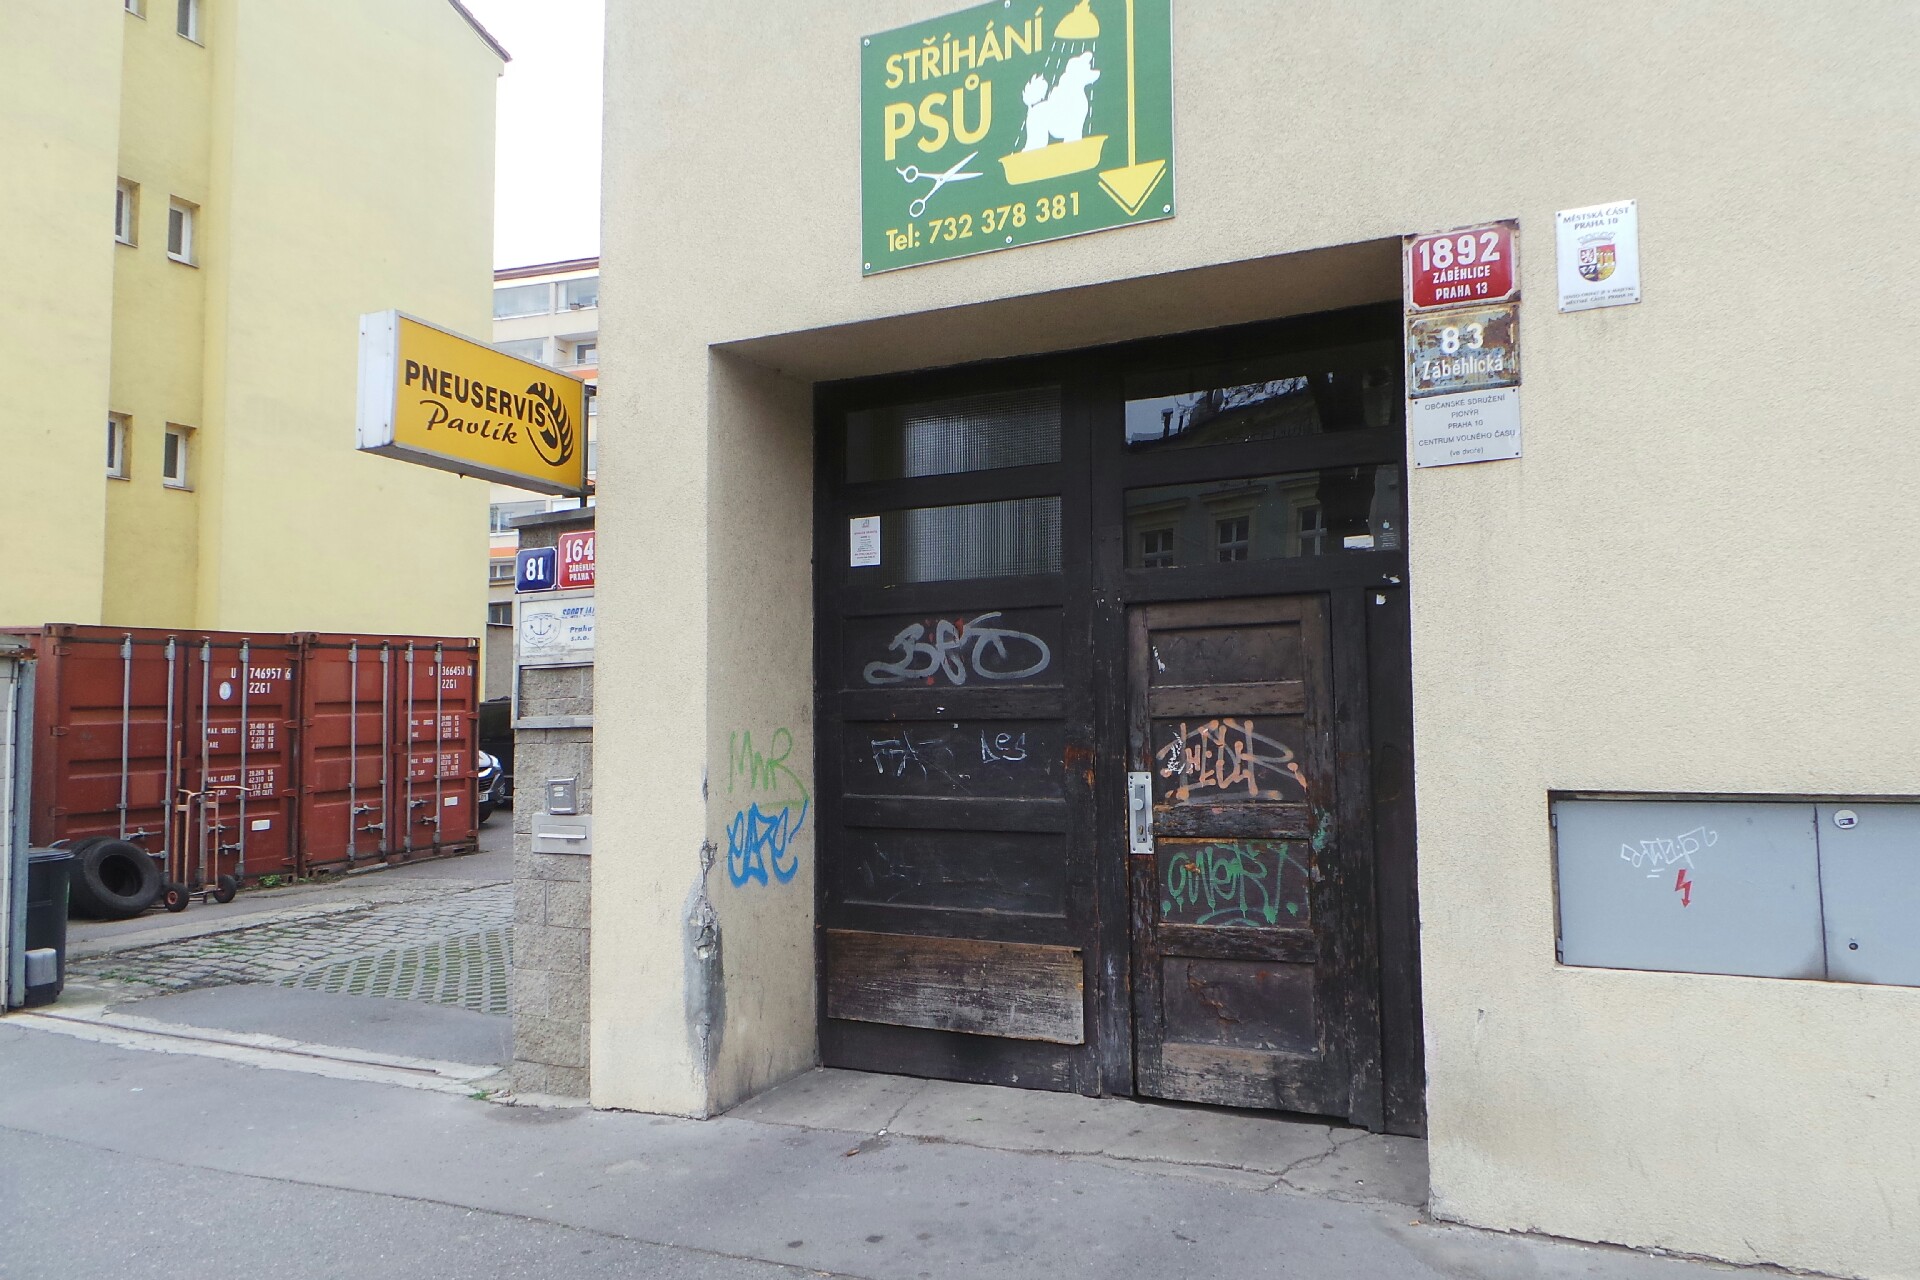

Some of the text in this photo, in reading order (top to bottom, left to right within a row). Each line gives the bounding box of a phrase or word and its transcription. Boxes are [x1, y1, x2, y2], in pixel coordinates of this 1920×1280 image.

[885, 6, 1043, 90] STŘÍHÁNÍ
[884, 74, 992, 161] PSŮ
[886, 192, 1080, 252] Tel: 732 378 381
[1574, 217, 1618, 231] PRAHA 10
[1419, 231, 1501, 272] 1892
[1432, 264, 1491, 284] ZÁBĚHLICE
[1436, 282, 1488, 301] PRAHA 13
[405, 359, 546, 428] PNEUSERVIS
[1424, 394, 1505, 411] OBČANSKÉ SDRUŽENÍ
[1451, 409, 1479, 418] PIONÝR
[1448, 421, 1472, 429] PRAHA
[1418, 429, 1515, 446] CENTRUM VOLNÉHO ČASU
[526, 556, 544, 581] 81
[569, 573, 590, 582] PRAHA
[231, 667, 292, 680] U 746957 6
[428, 666, 434, 676] U
[249, 682, 271, 694] 22G1
[441, 679, 457, 689] 22G1
